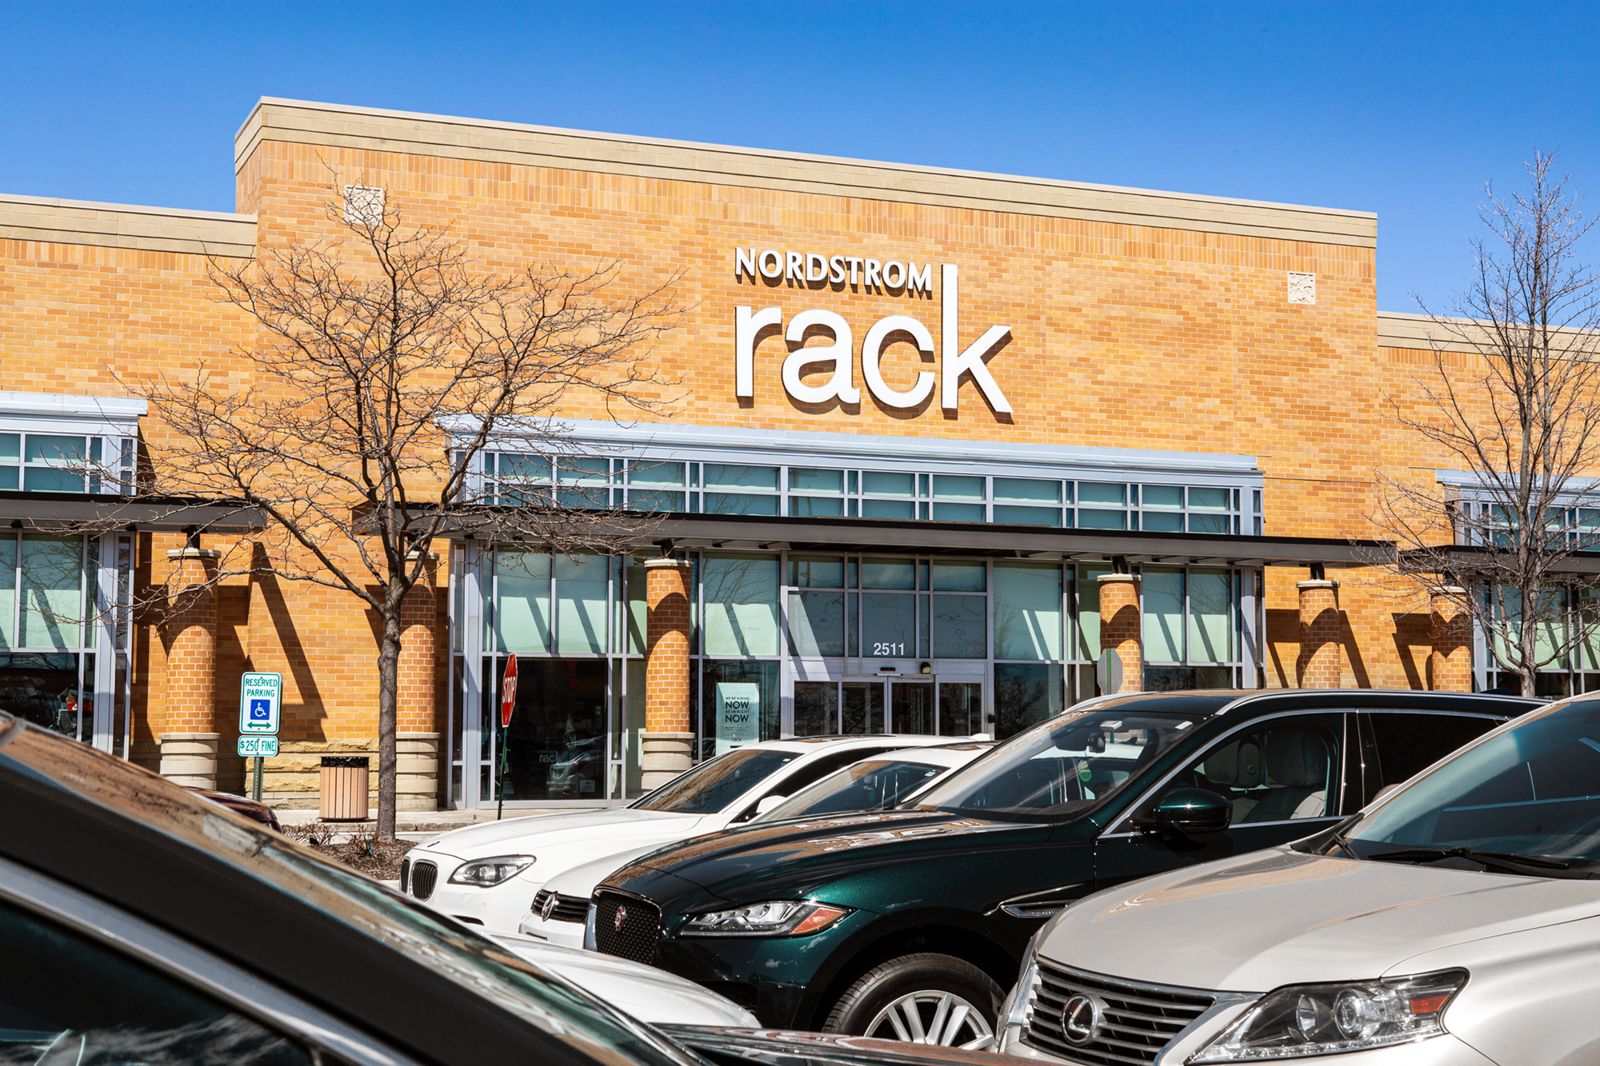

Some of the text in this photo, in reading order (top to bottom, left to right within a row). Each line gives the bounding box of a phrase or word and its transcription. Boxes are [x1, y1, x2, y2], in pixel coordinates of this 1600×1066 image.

[735, 247, 932, 292] NORDSTROM
[735, 264, 1014, 413] rack
[873, 642, 904, 656] 2511
[245, 679, 278, 687] RESERVED
[502, 676, 516, 703] STOP
[246, 688, 275, 697] PARKING
[240, 740, 276, 752] $250 FINE
